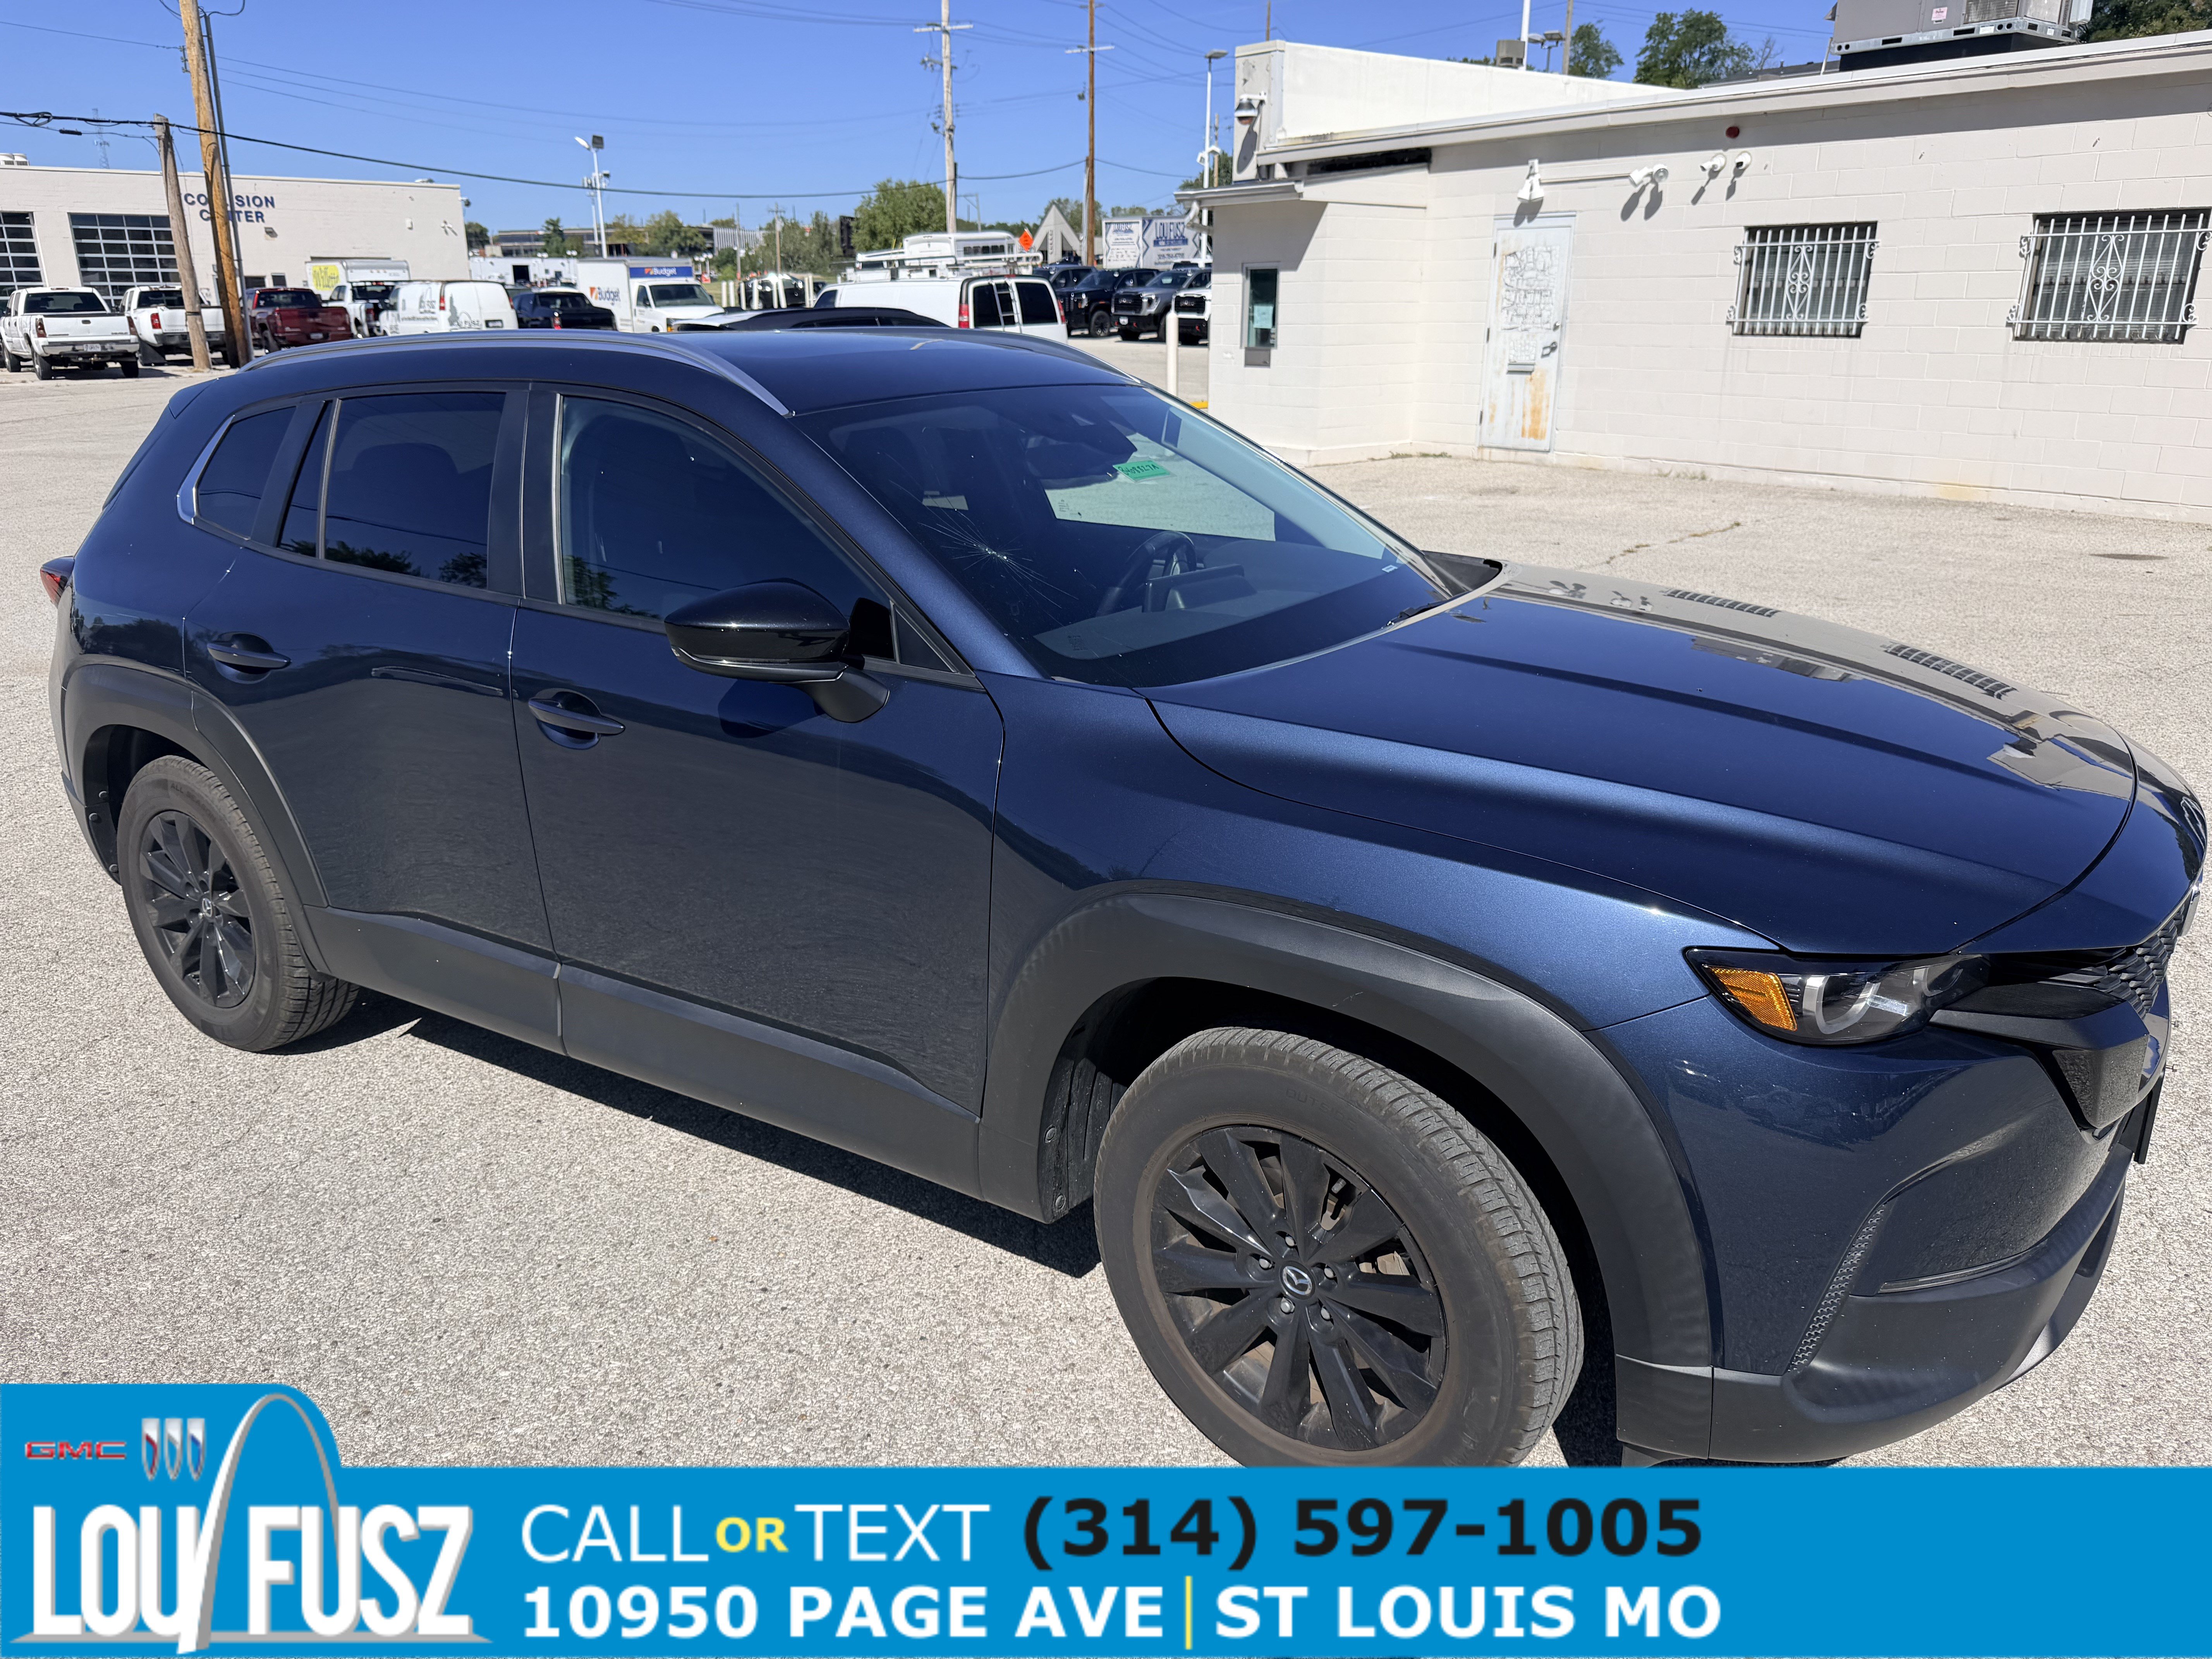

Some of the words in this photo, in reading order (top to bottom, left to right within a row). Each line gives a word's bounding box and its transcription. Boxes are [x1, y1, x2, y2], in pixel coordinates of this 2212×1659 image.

[184, 193, 275, 208] COSION
[199, 210, 265, 223] CTER
[653, 267, 677, 277] Budget
[598, 287, 621, 306] Budget
